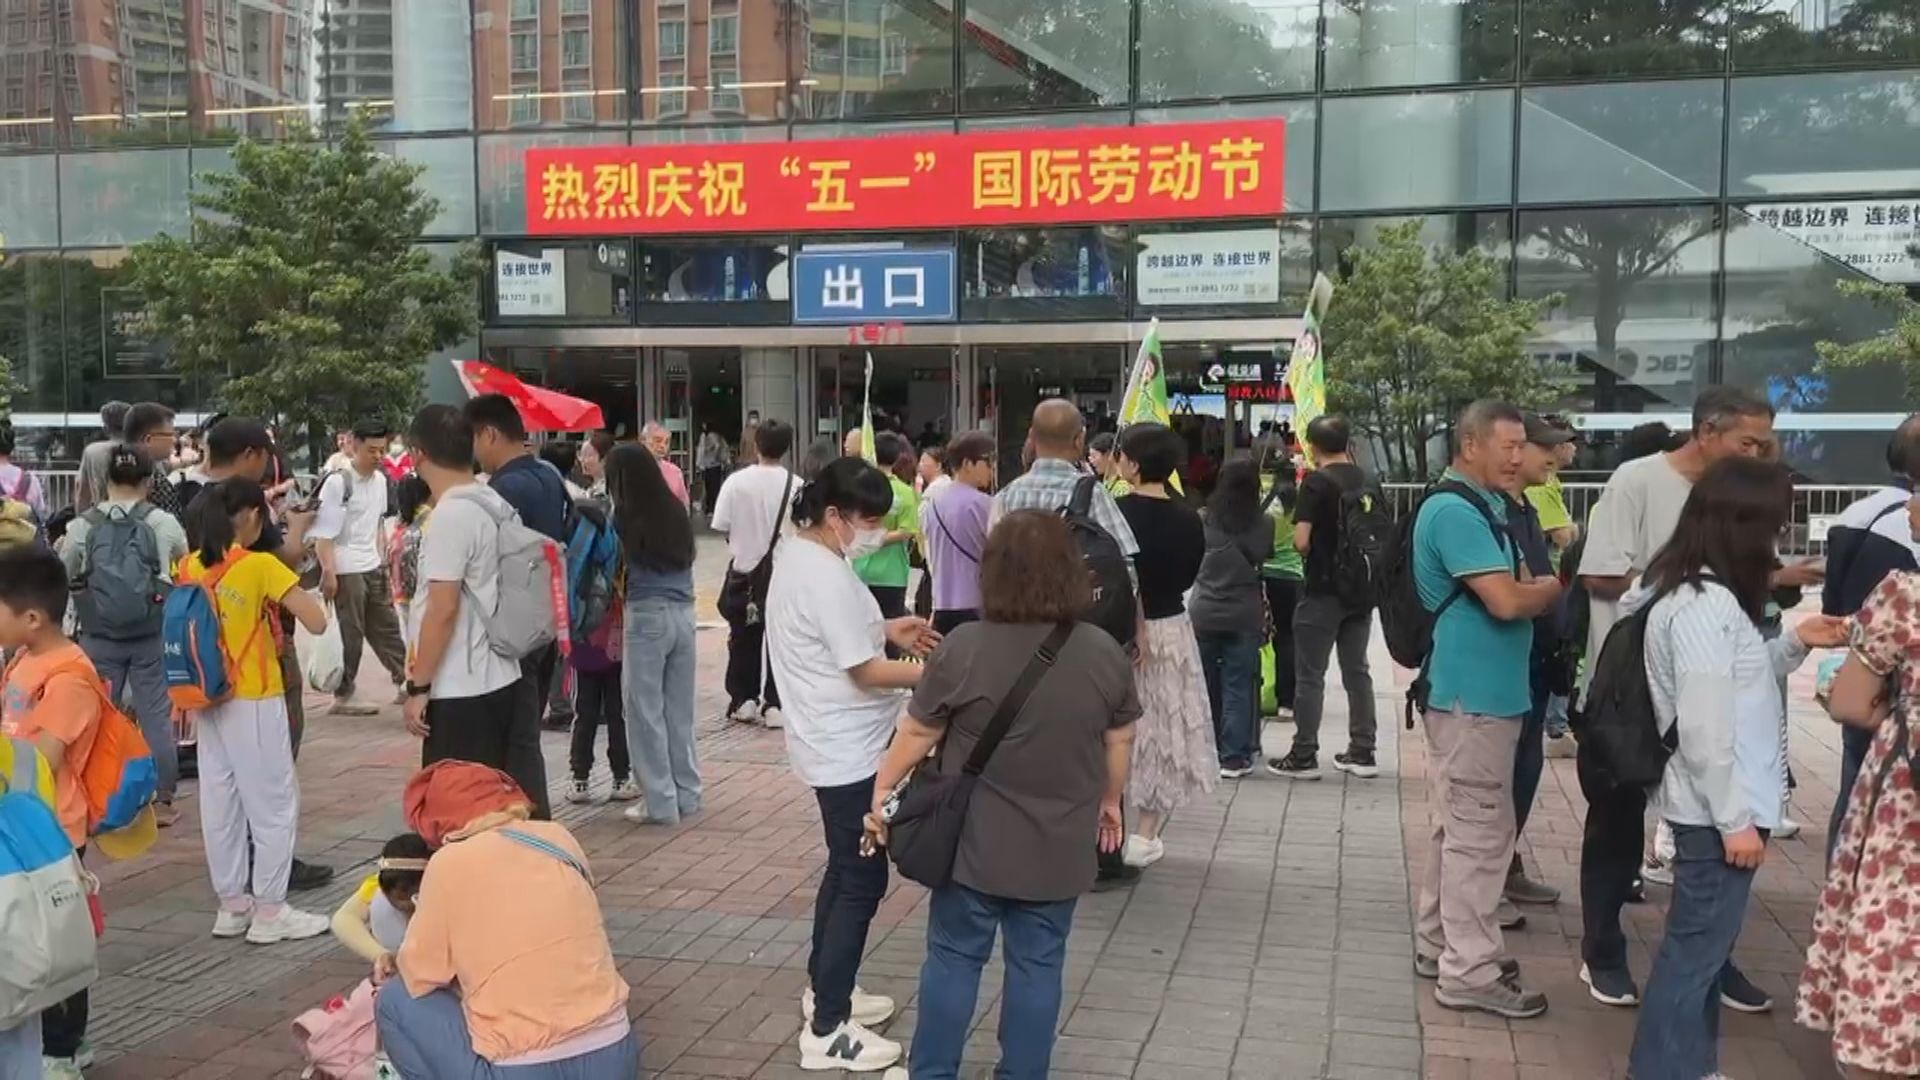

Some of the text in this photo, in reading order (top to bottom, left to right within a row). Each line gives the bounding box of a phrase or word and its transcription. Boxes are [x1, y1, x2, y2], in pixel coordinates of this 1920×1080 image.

[543, 160, 747, 220] 热烈庆祝
[973, 137, 1265, 209] 国际劳动节
[502, 262, 552, 276] 连接世界
[1146, 250, 1272, 268] 跨越边界 连接世界
[822, 264, 925, 309] 出口
